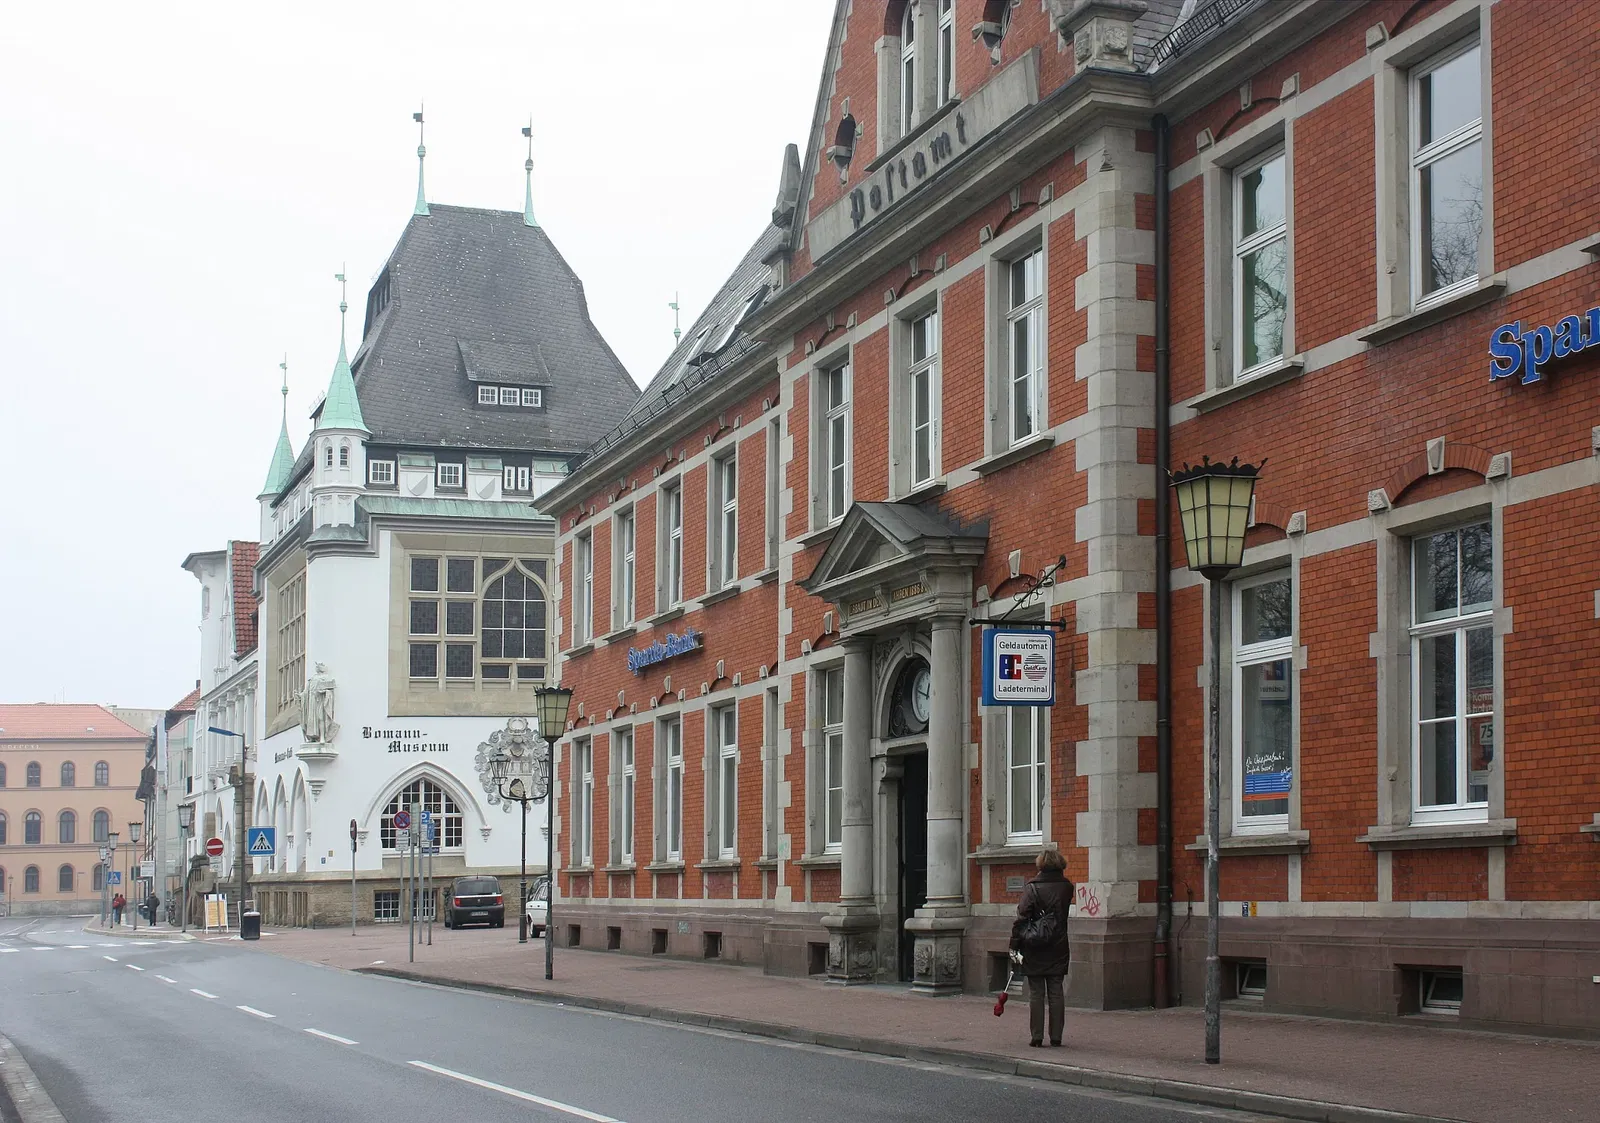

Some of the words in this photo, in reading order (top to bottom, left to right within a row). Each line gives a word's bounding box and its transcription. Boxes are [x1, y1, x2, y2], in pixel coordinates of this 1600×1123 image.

[999, 641, 1048, 650] Geldautomat
[998, 684, 1048, 693] Ladeterminal
[362, 726, 428, 739] Bomann-
[388, 740, 449, 753] Museum
